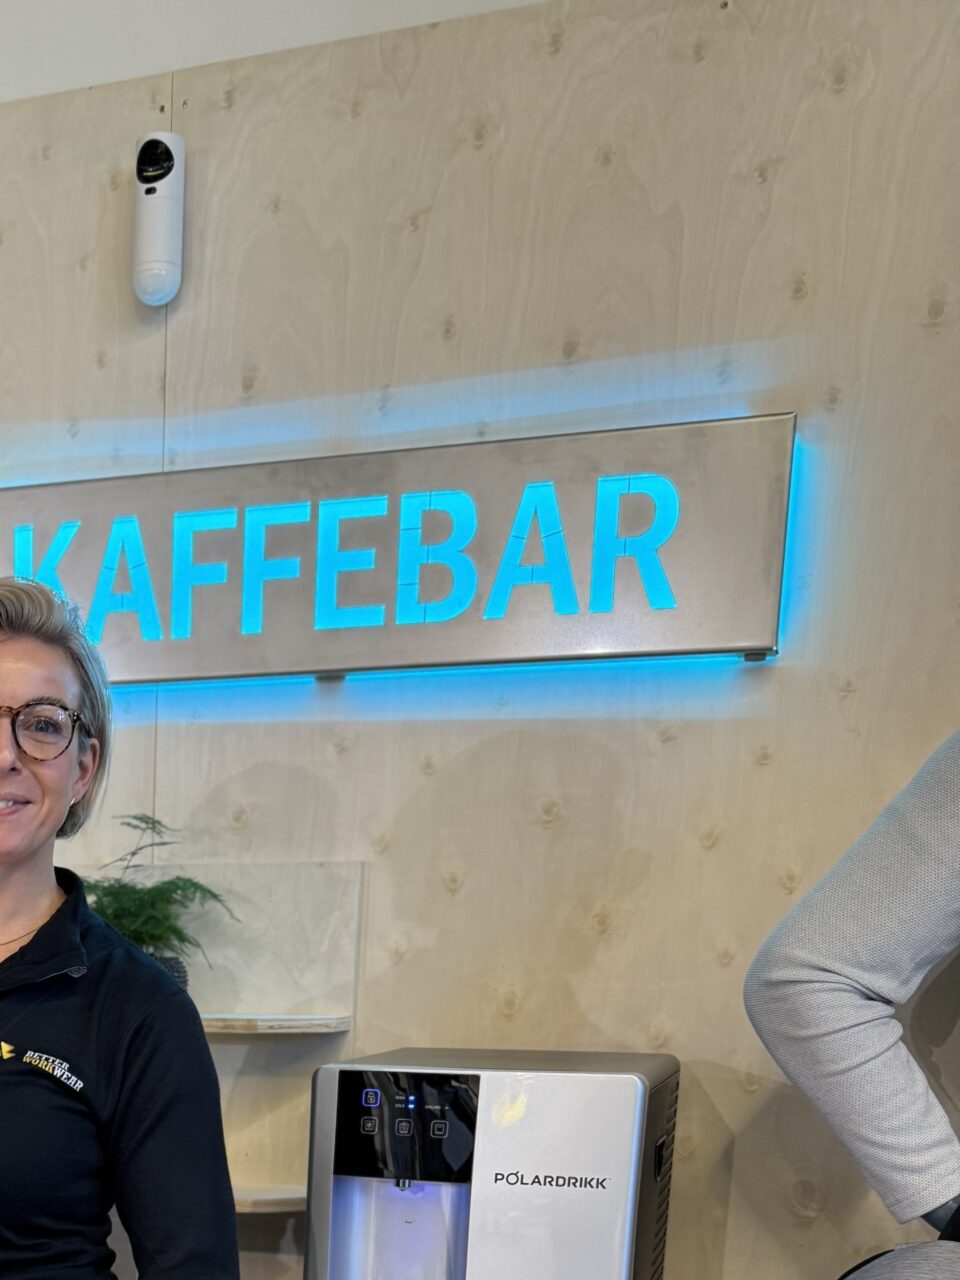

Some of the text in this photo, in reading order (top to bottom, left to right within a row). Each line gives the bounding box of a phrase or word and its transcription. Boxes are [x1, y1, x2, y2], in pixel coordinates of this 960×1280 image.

[13, 472, 680, 645] KAFFEBAR
[22, 1056, 85, 1092] WORKWEAR
[25, 1050, 70, 1071] BETTER
